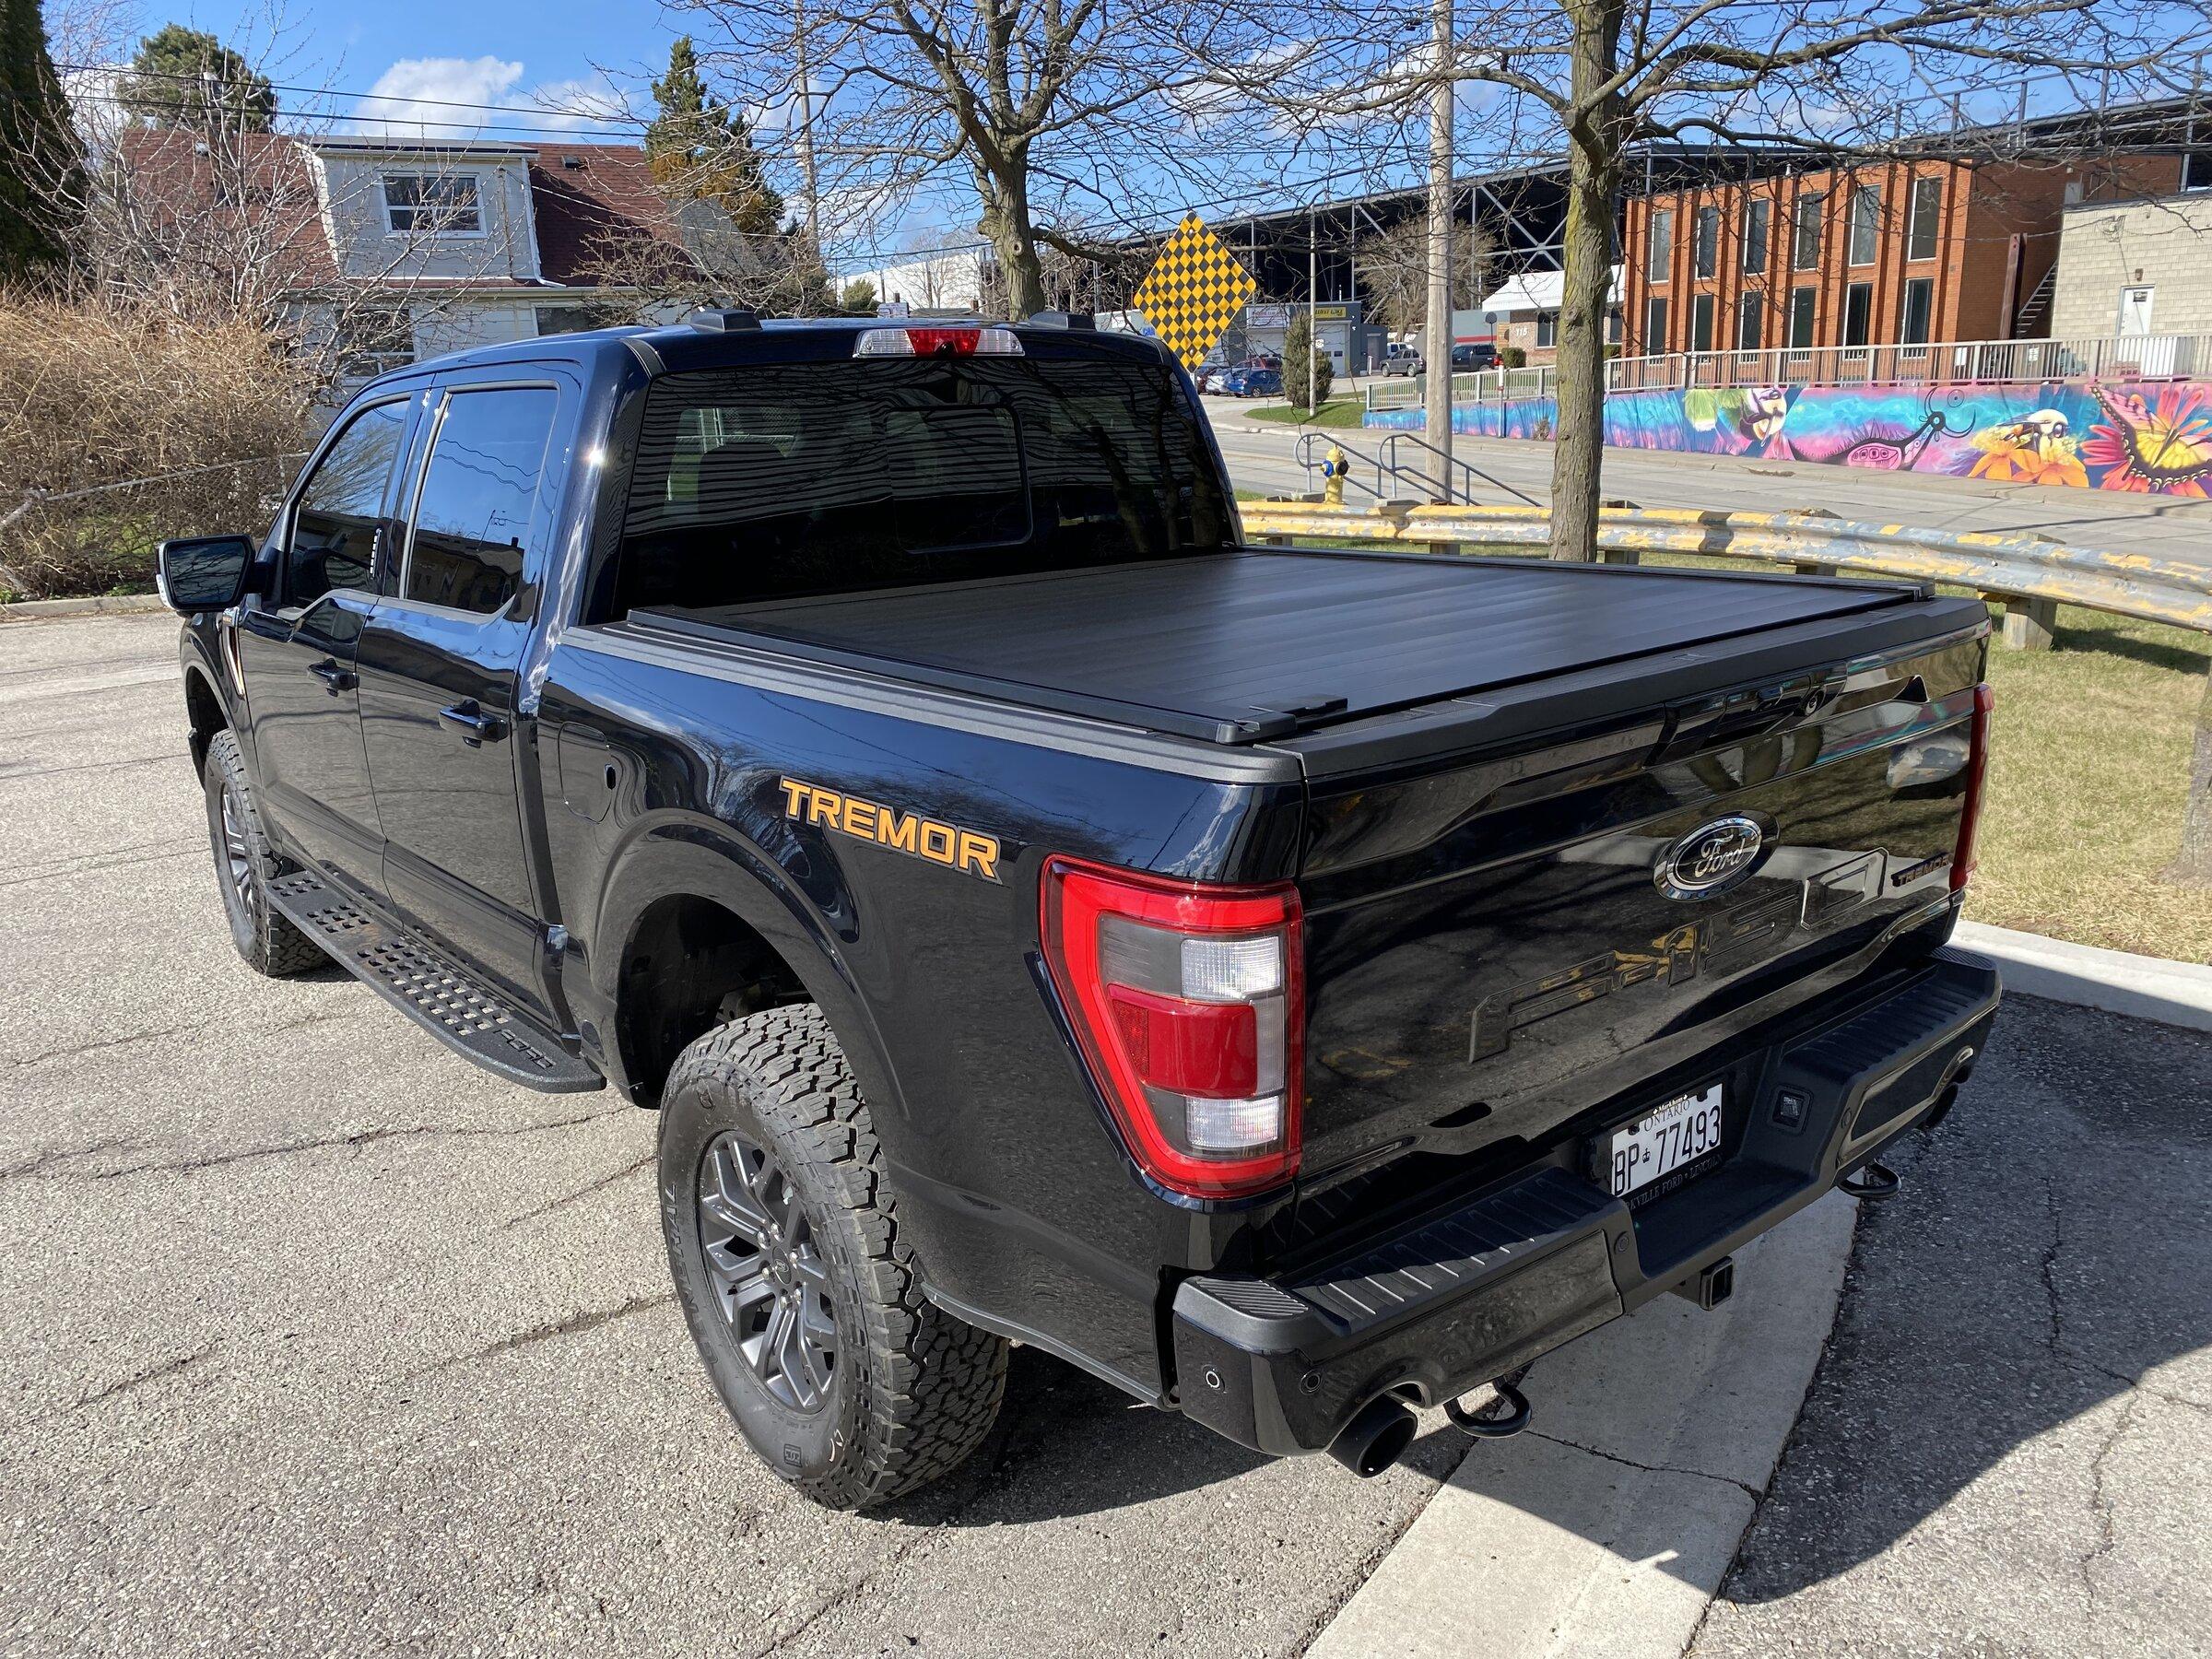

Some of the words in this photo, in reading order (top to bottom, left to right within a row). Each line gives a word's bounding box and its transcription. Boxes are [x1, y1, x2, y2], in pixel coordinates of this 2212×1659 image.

[1516, 325, 1528, 336] 115
[779, 775, 1002, 884] TREMOR
[1694, 834, 1746, 877] Ford
[1468, 847, 1888, 1064] F-150
[493, 1028, 558, 1071] FORD
[1644, 1100, 1690, 1132] ONTARIO
[1654, 1104, 1721, 1174] 77493
[1662, 1173, 1683, 1194] FORD
